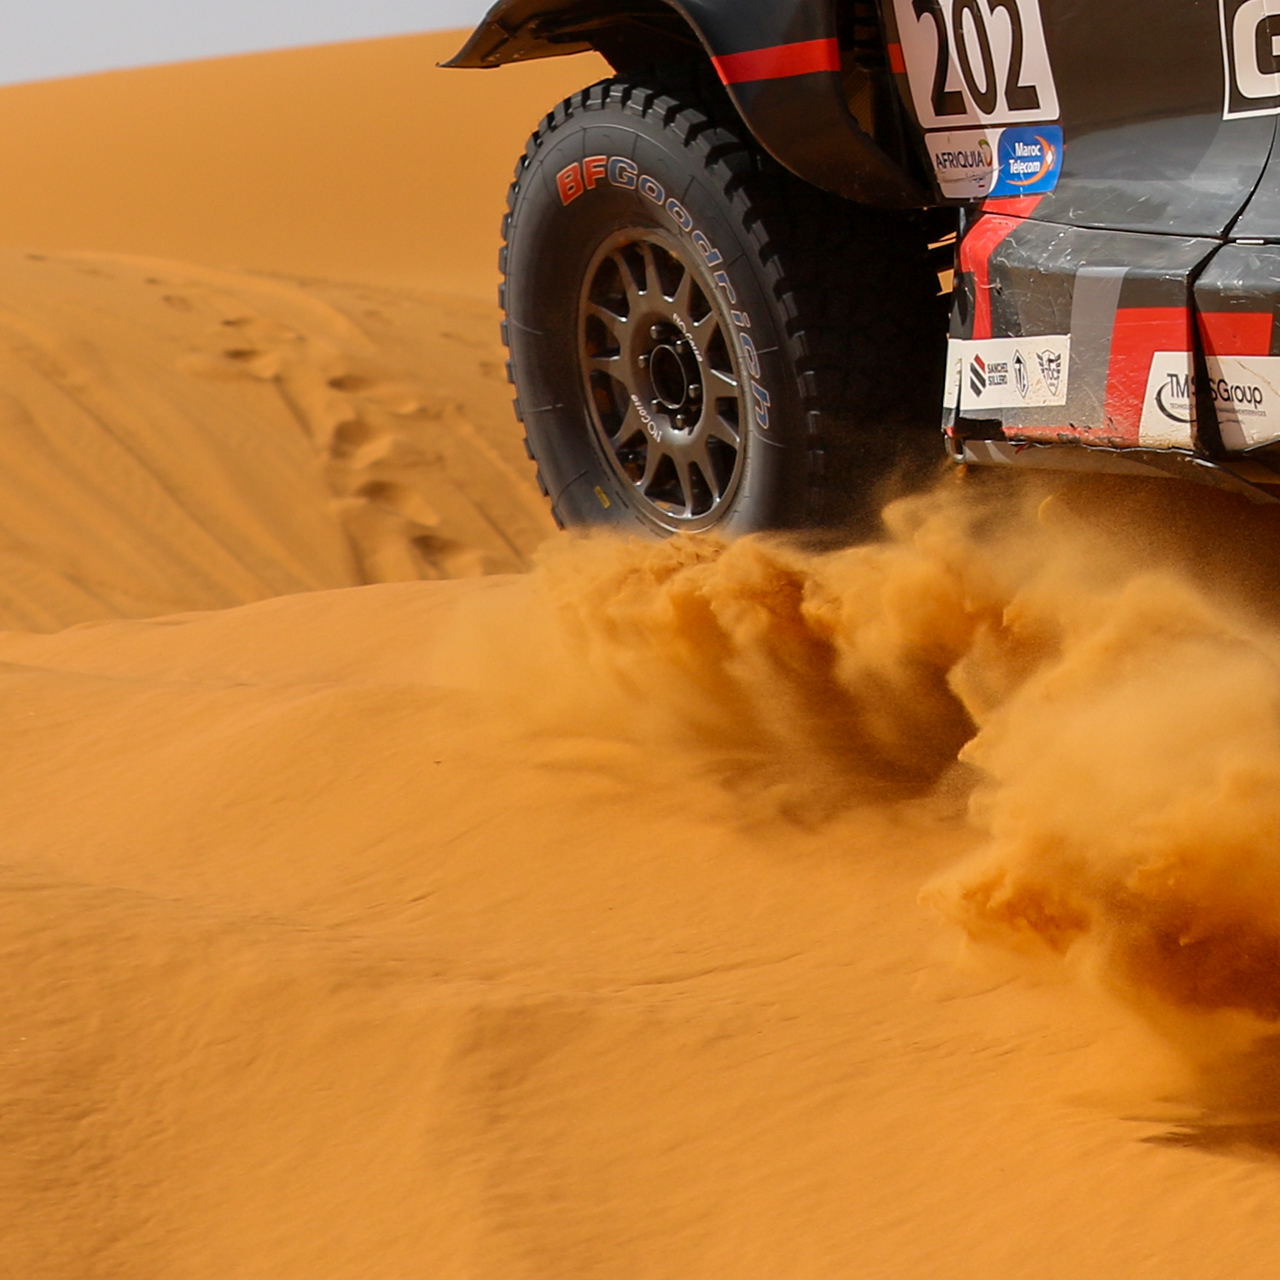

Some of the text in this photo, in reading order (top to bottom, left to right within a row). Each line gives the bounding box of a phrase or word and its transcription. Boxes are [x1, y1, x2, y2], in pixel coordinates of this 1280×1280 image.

[1014, 142, 1042, 157] Maroc
[935, 150, 985, 169] AFRIQUIA
[1009, 159, 1041, 174] Telecom
[556, 154, 773, 430] BFGoodrich
